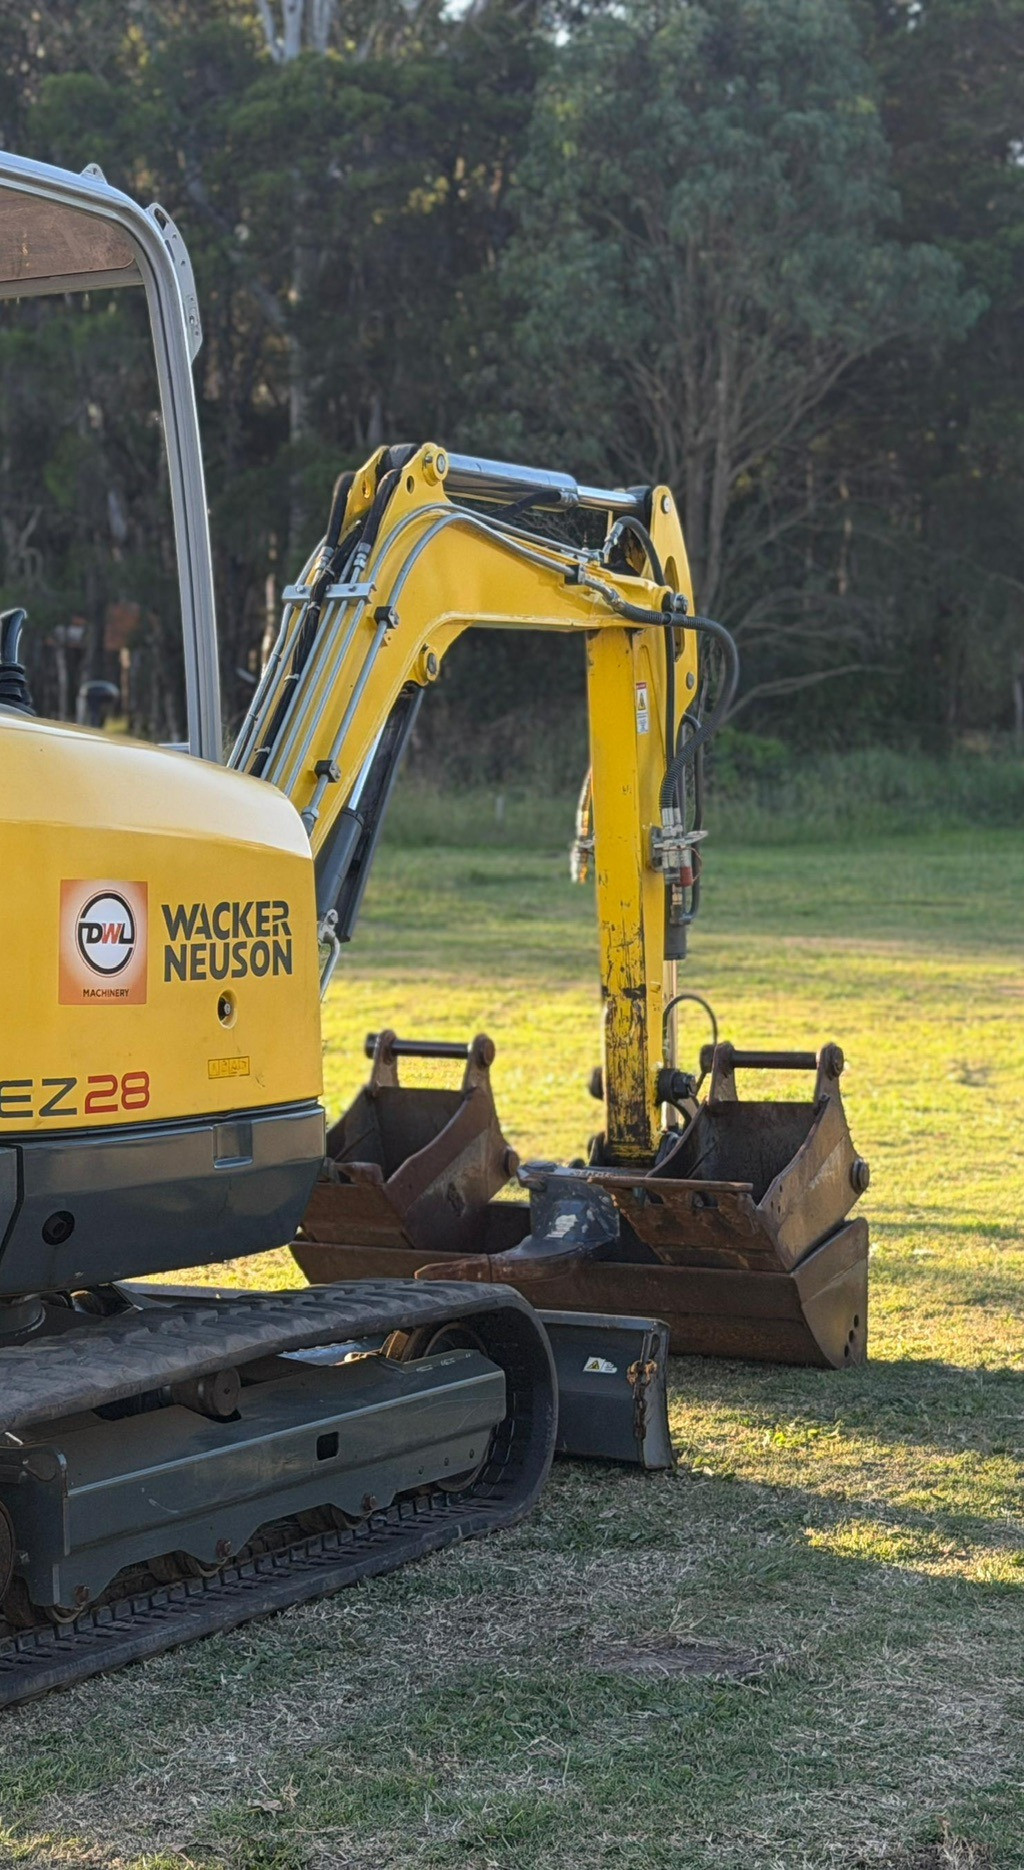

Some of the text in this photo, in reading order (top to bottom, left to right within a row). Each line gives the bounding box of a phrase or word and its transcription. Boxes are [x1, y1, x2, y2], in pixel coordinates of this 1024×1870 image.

[78, 922, 135, 945] DWL
[161, 900, 292, 941] WACKER
[164, 938, 293, 983] NEUSON
[82, 988, 130, 998] MACHINERY
